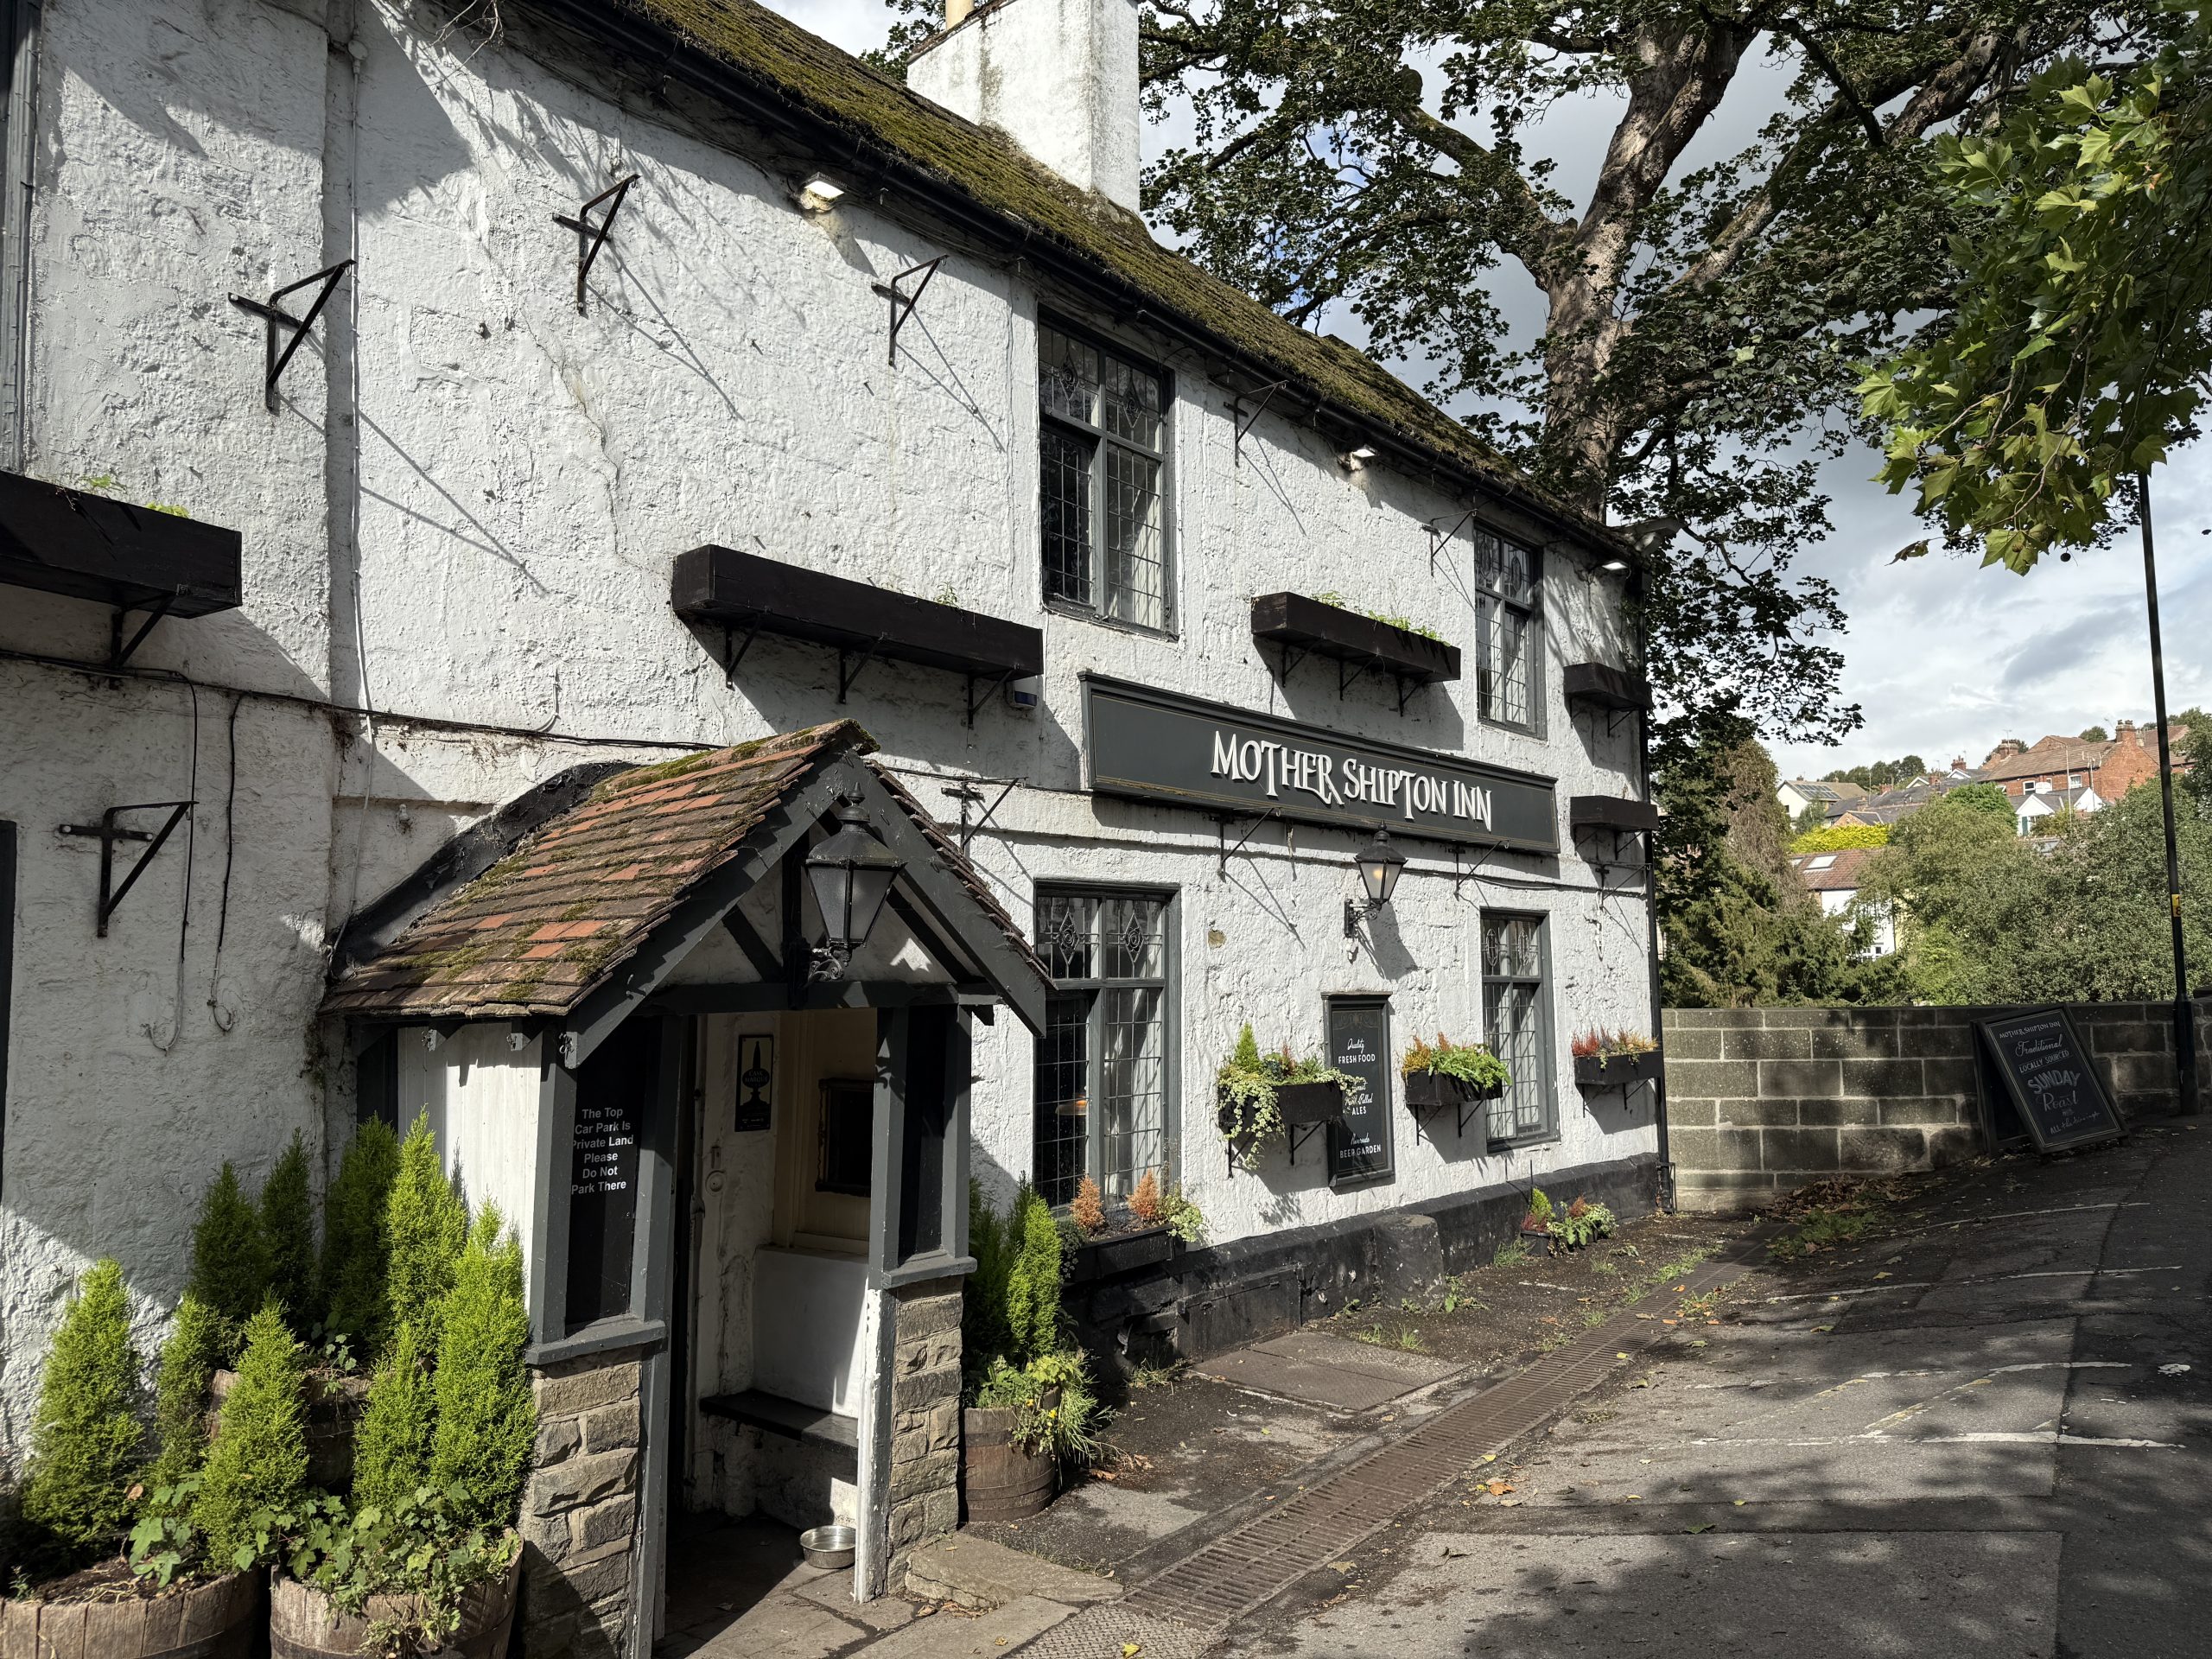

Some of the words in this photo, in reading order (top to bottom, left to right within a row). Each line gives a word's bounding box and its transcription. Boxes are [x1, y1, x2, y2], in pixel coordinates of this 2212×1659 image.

[1211, 730, 1344, 805] MOTHER
[1342, 758, 1448, 820] SHIPTON
[1452, 779, 1491, 832] INN
[1999, 1028, 2025, 1039] MOTHER
[2024, 1023, 2049, 1033] SHIPTON
[1347, 1038, 1365, 1054] Quality
[2015, 1033, 2063, 1057] Traditional
[1338, 1055, 1357, 1065] FRESH
[1358, 1053, 1376, 1063] FOOD
[2018, 1058, 2043, 1073] LOCALLY
[2045, 1049, 2069, 1064] SOURCED
[2027, 1070, 2081, 1094] SUNDAY
[2042, 1090, 2078, 1112] Roast
[582, 1109, 601, 1119] The
[604, 1107, 623, 1119] Top
[1351, 1106, 1367, 1116] ALES
[575, 1124, 594, 1135] Car
[596, 1122, 619, 1133] Park
[622, 1121, 631, 1130] Is
[608, 1135, 634, 1147] Land
[584, 1153, 618, 1164] Please
[1339, 1147, 1355, 1159] BEER
[1357, 1144, 1382, 1156] GARDEN
[582, 1168, 597, 1179] Do
[600, 1166, 618, 1177] Not
[571, 1183, 595, 1195] Park
[598, 1180, 626, 1192] There
